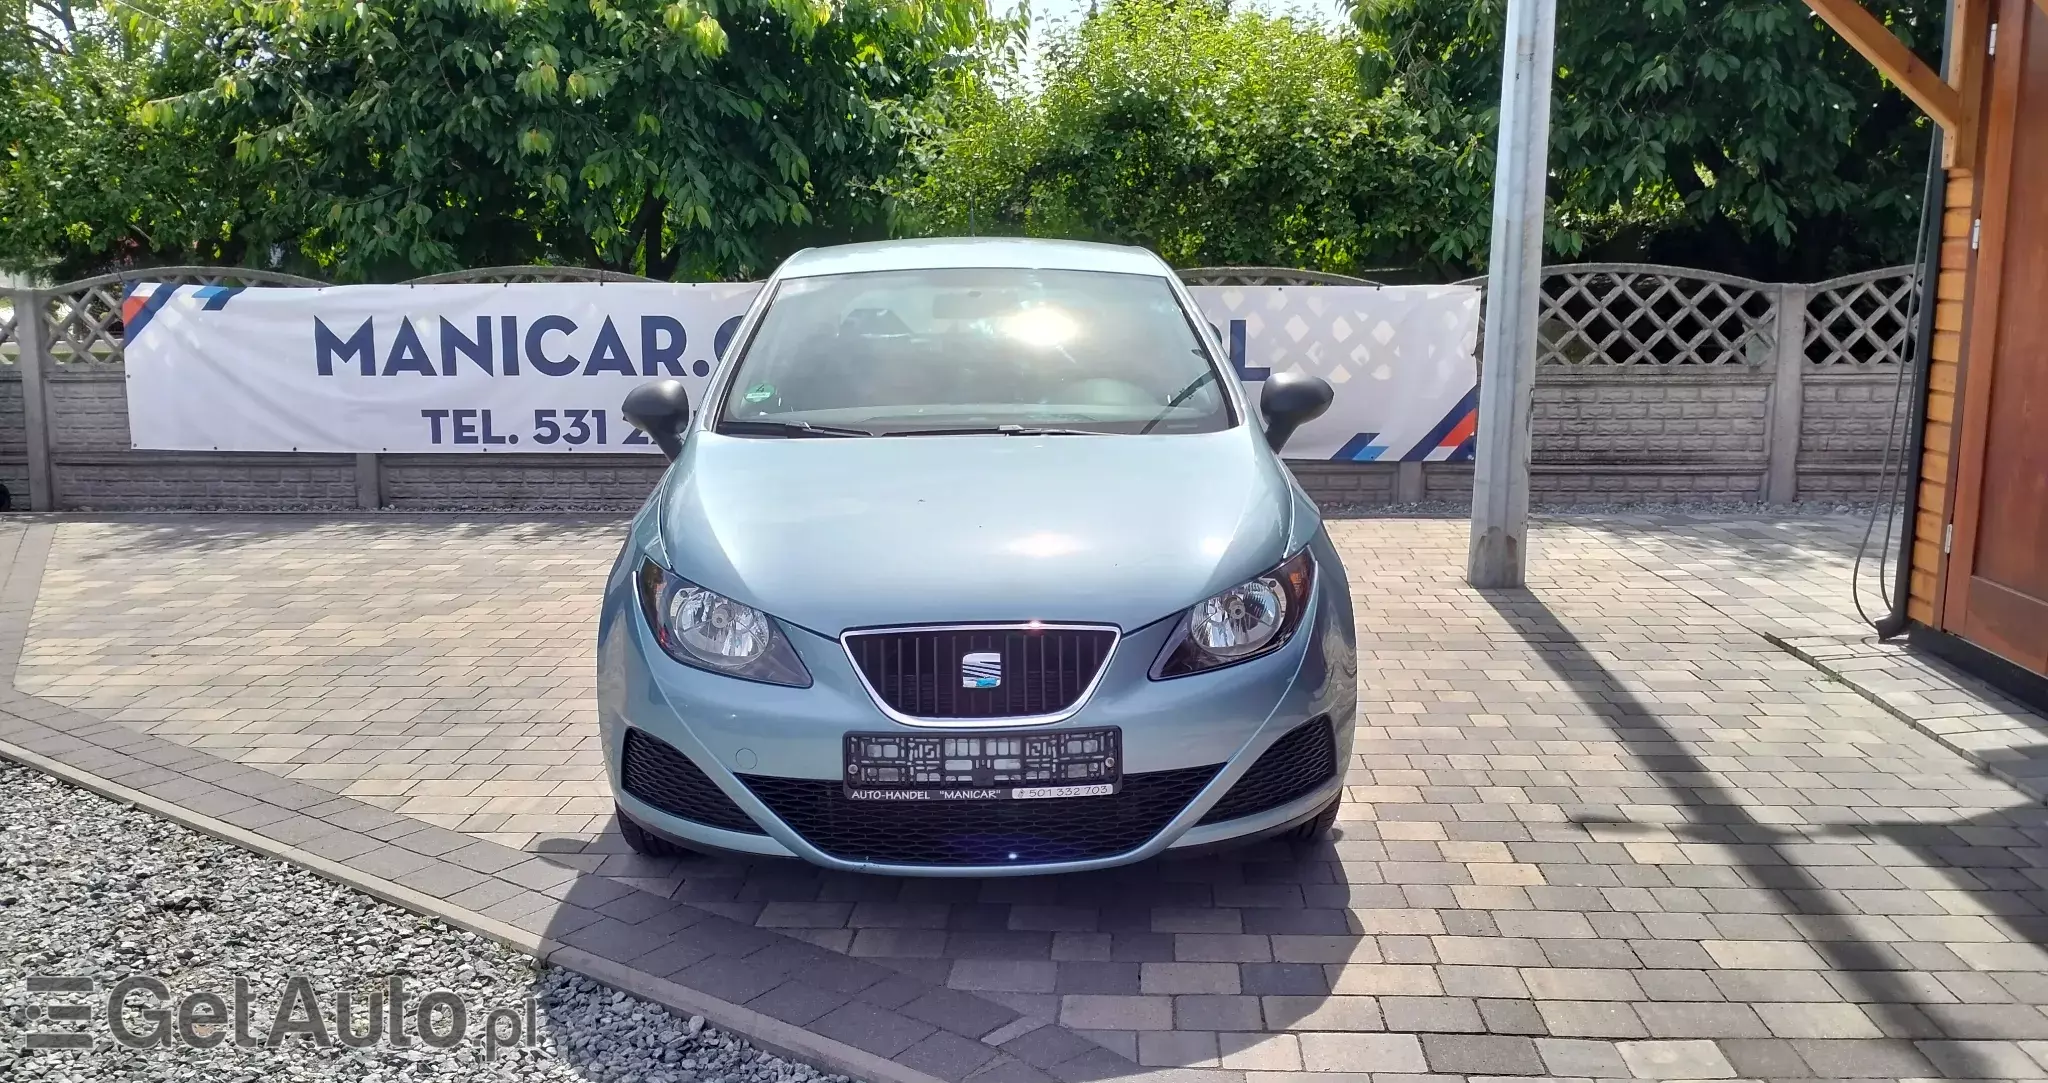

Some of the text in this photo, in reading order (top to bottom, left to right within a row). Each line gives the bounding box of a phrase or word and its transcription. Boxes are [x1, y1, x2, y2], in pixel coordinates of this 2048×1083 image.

[421, 409, 519, 445] TEL.
[533, 409, 607, 445] 531
[851, 785, 1108, 800] AUTO-HANDEL "MANICAR" 501 332 703
